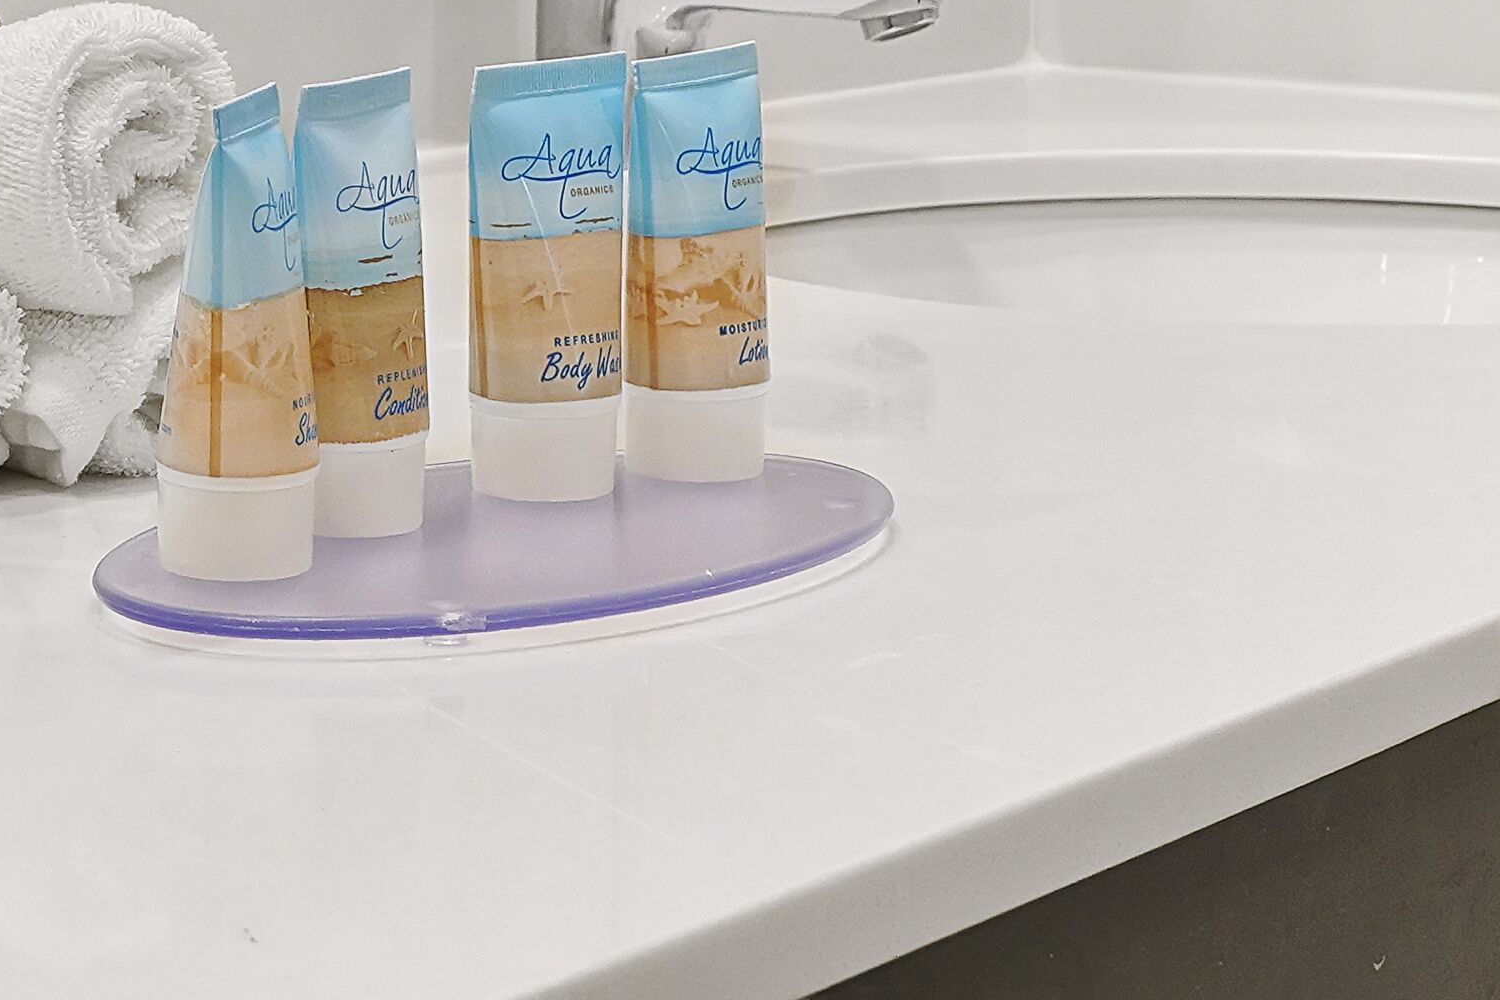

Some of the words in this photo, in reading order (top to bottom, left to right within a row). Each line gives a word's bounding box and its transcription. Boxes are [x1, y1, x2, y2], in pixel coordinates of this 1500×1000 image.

[336, 160, 420, 250] Aqua
[501, 132, 621, 219] Aqua
[570, 184, 615, 198] ORGANICS
[676, 126, 762, 210] Aqua
[251, 176, 298, 272] Aqu
[540, 350, 594, 391] Body
[596, 343, 621, 379] Was
